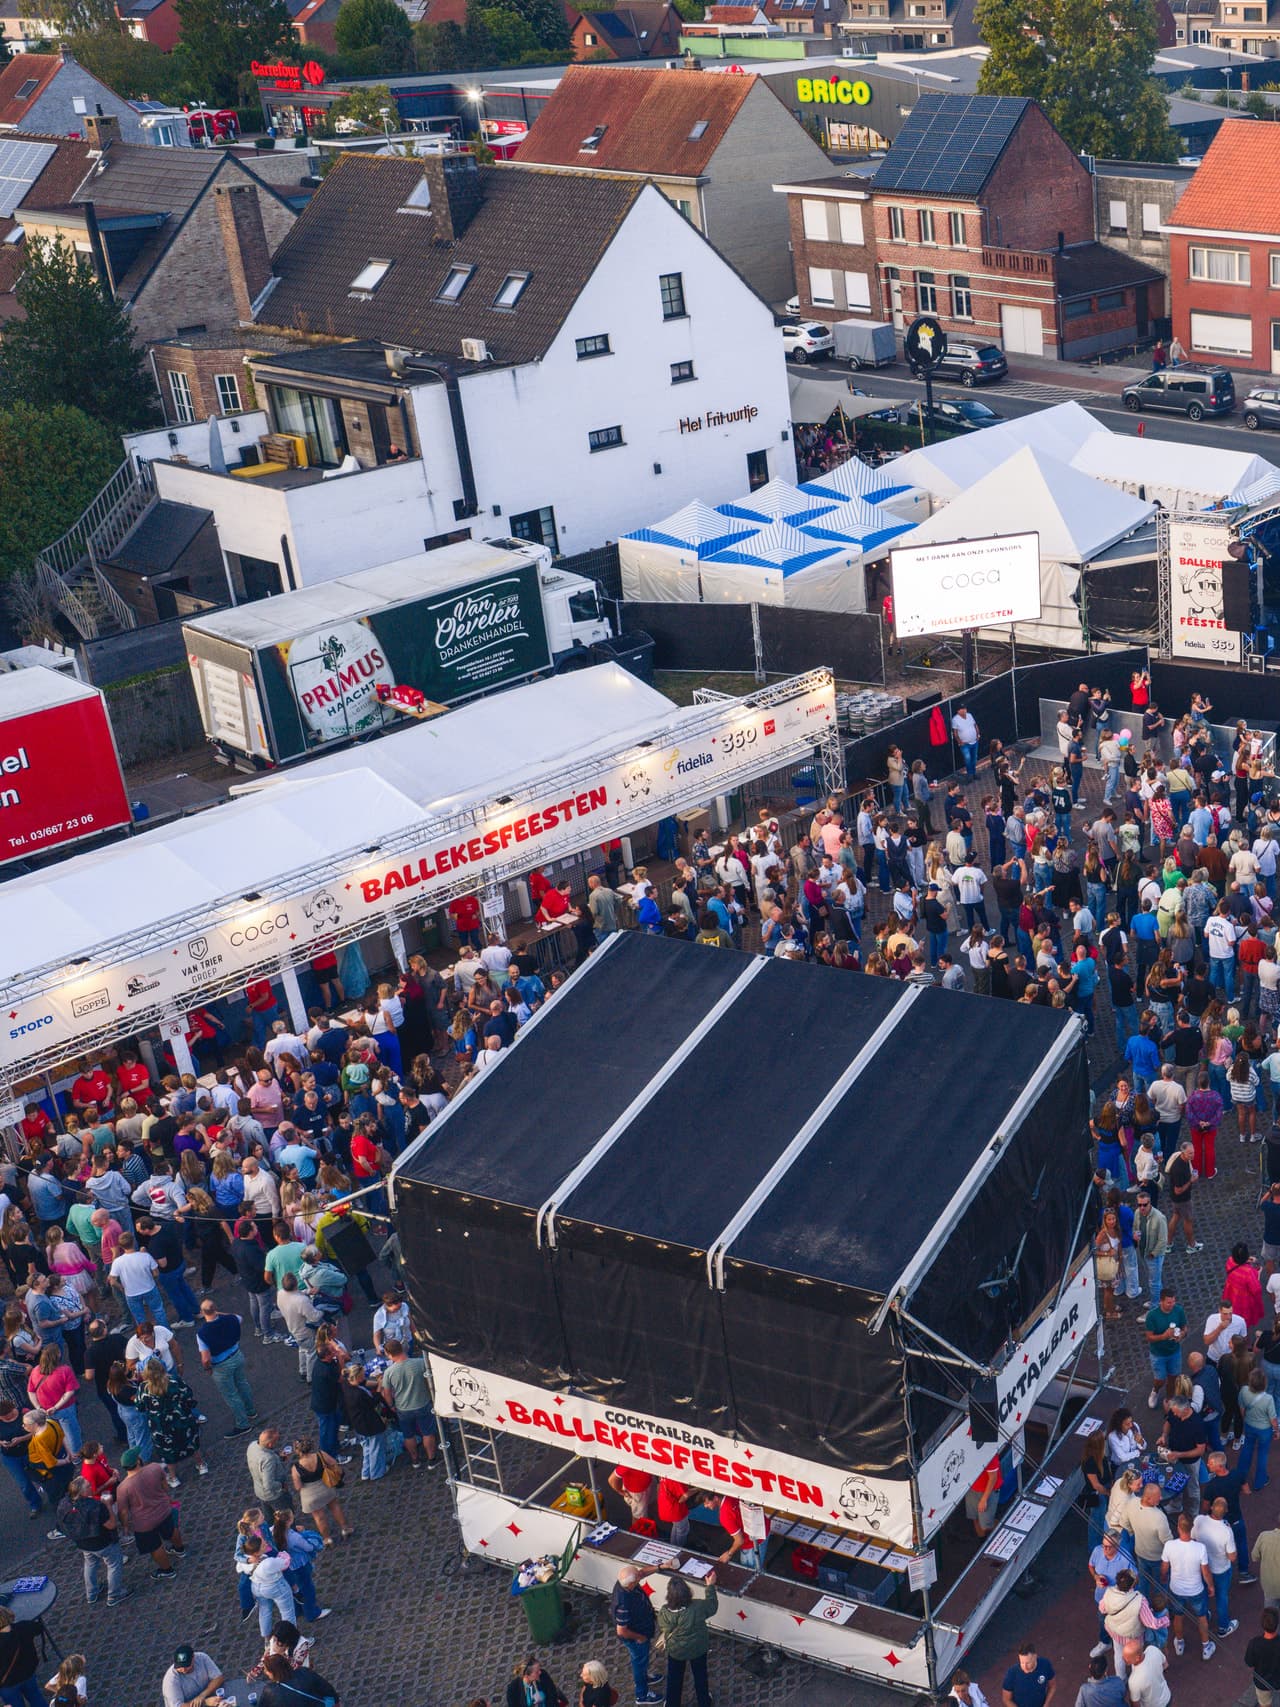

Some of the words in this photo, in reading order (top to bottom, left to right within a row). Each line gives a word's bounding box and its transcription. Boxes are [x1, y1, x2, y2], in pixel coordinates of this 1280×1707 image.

[251, 60, 299, 78] Carrefour
[679, 416, 702, 434] Het
[706, 404, 758, 428] Frituurtje
[1179, 557, 1223, 569] BALLEKE
[454, 594, 494, 622] Van
[1180, 617, 1227, 629] FEESTE
[440, 620, 525, 661] DRANKENHANDEL
[301, 648, 385, 714] PRIMUS
[326, 679, 377, 717] HAACHT
[721, 726, 757, 753] 360
[677, 752, 714, 775] fidelia
[8, 834, 29, 848] Tel.
[30, 823, 63, 841] 03/667
[66, 818, 79, 830] 23
[81, 813, 94, 825] 06
[360, 785, 607, 903] BALLEKESFEESTEN
[181, 963, 199, 977] VAN
[200, 954, 223, 970] TRIER
[191, 967, 218, 984] GROEP
[77, 997, 108, 1014] JOPPE
[505, 1400, 824, 1508] BALLEKESFEESTEN
